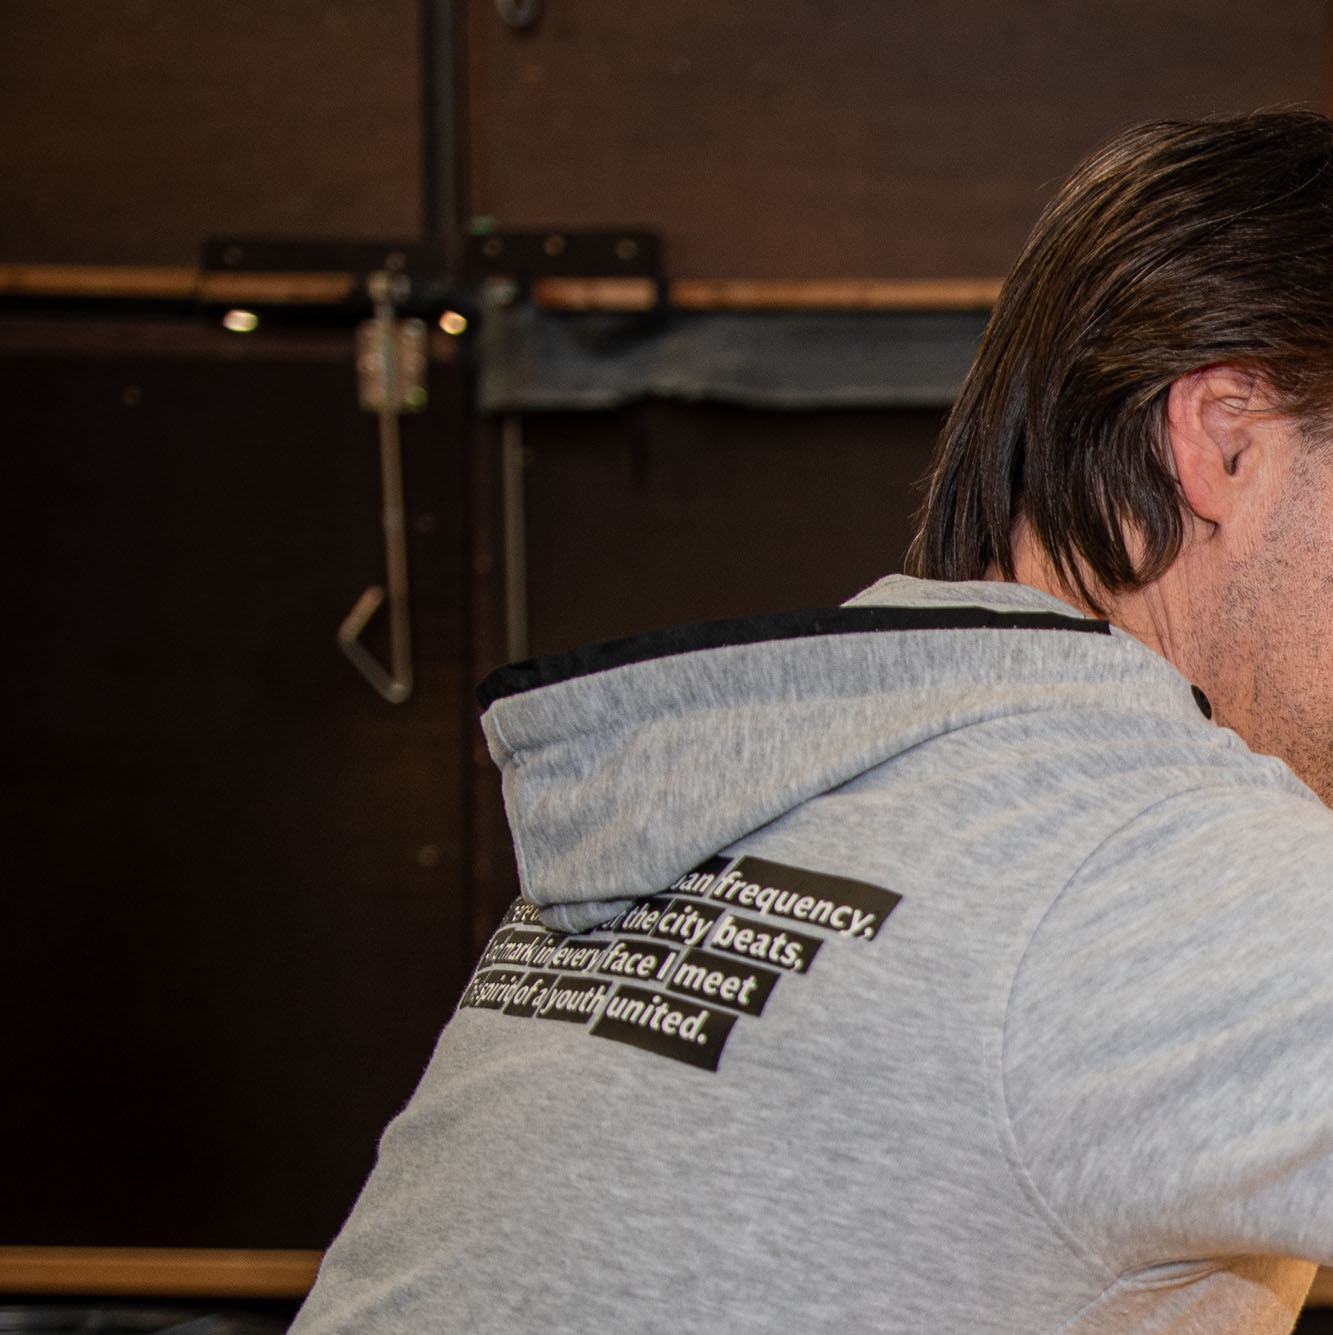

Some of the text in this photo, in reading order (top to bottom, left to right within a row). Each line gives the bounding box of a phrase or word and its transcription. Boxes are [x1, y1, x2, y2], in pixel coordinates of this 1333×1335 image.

[712, 871, 878, 939] frequency,
[622, 903, 660, 931] the
[657, 905, 715, 946] city
[711, 914, 805, 970] beats,
[512, 978, 544, 1006] of
[532, 938, 556, 964] in
[552, 946, 602, 974] every
[602, 942, 658, 977] face
[656, 952, 677, 981] I
[673, 962, 759, 1006] meet
[532, 989, 549, 1007] a
[540, 984, 607, 1015] youth
[606, 995, 709, 1045] united.
